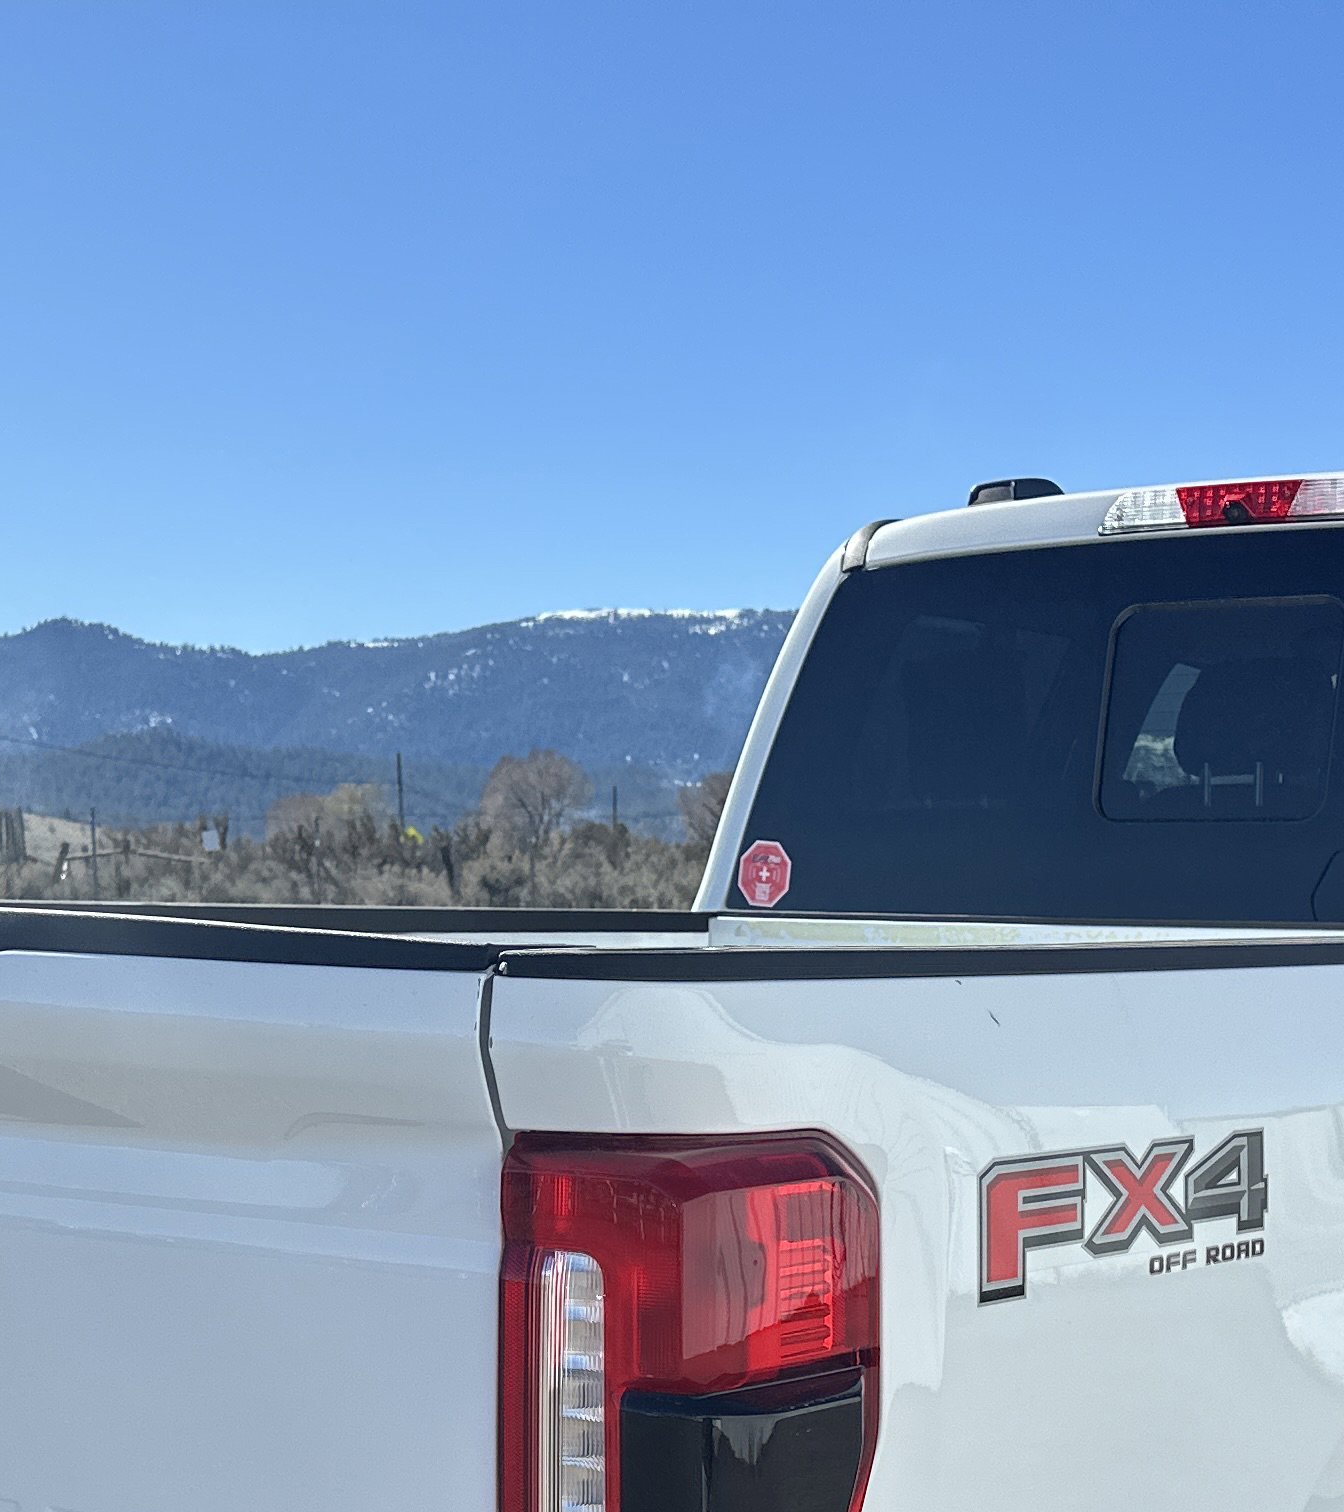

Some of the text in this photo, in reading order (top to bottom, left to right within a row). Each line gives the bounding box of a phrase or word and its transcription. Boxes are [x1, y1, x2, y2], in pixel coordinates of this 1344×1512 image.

[977, 1128, 1268, 1307] FX4
[1149, 1237, 1266, 1276] OFF ROAD
